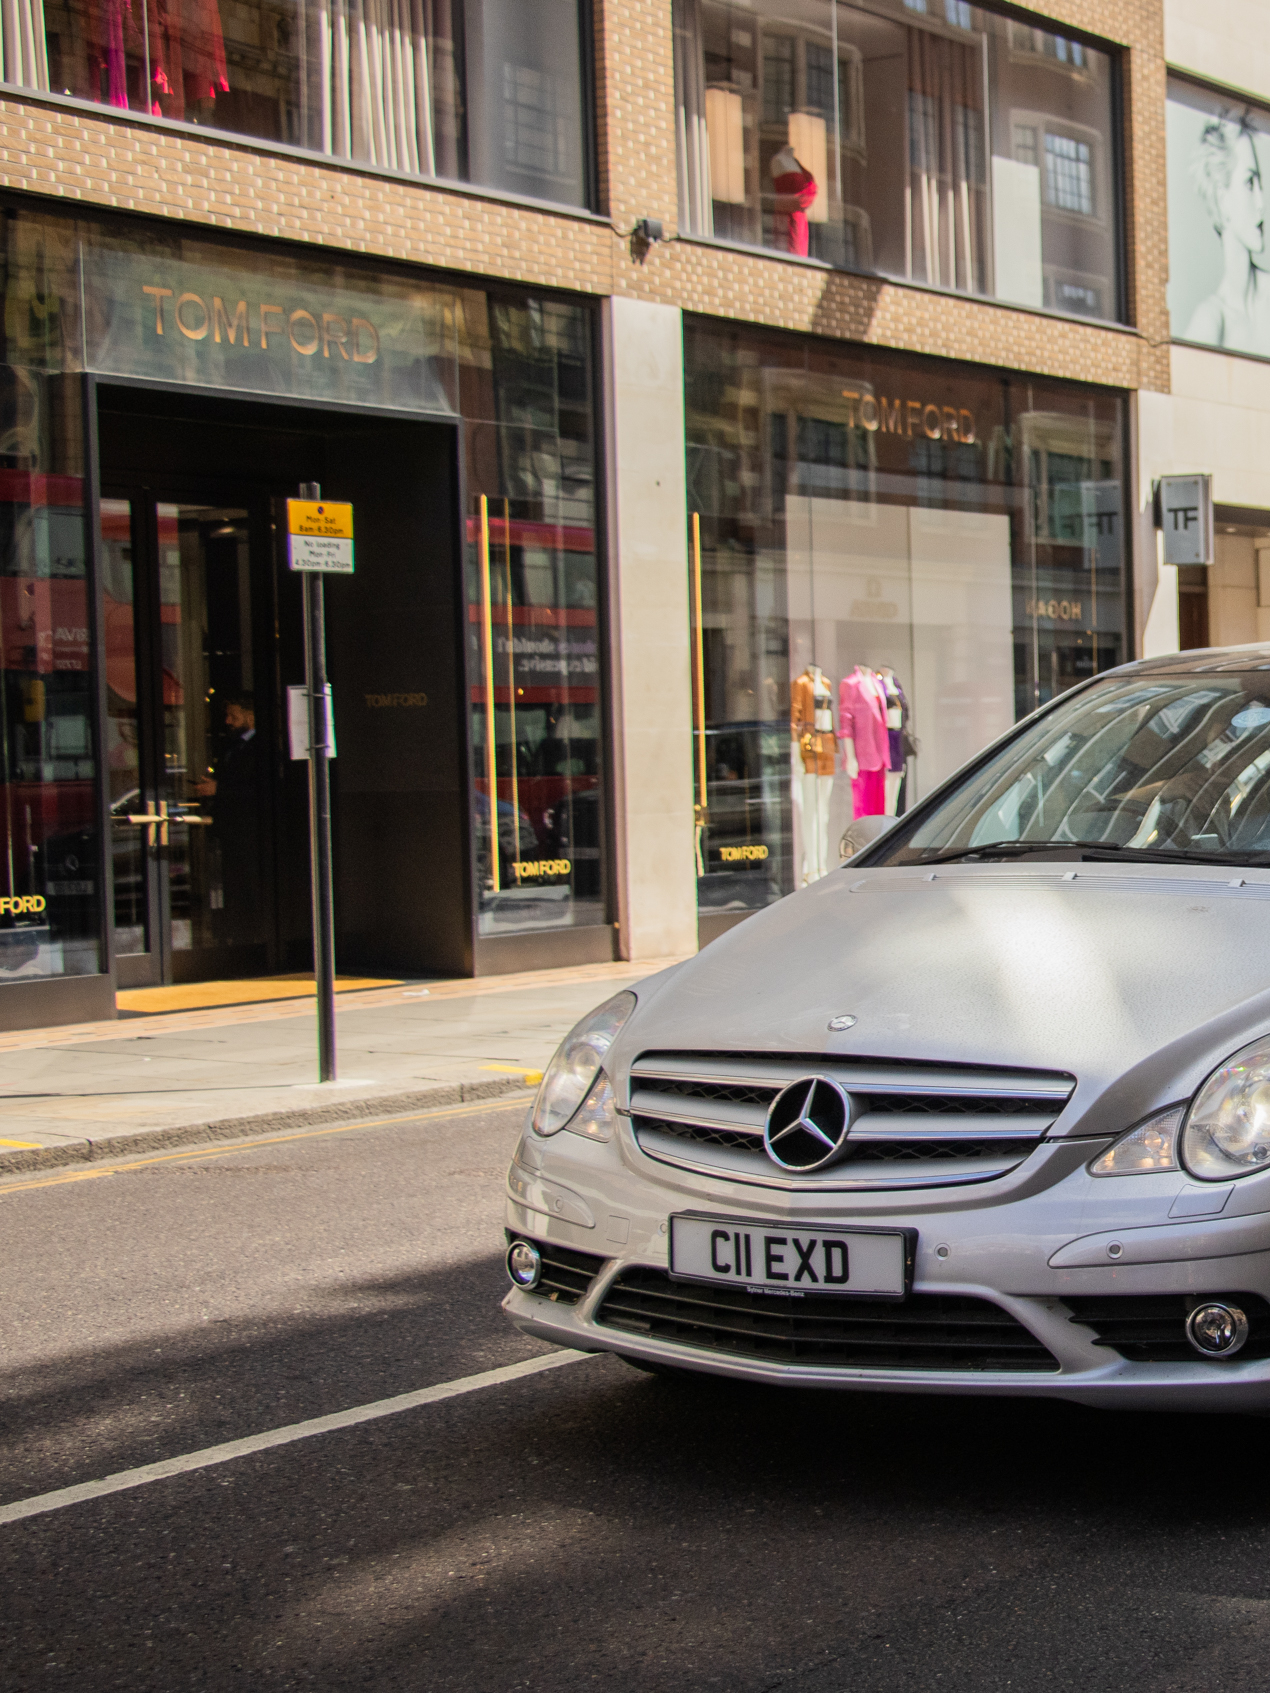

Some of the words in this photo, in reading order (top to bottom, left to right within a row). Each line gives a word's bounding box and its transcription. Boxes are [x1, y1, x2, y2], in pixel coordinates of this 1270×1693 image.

[142, 285, 249, 347] TOM
[260, 303, 380, 364] FORD
[842, 390, 903, 433] TOM
[906, 400, 976, 444] FORD
[1166, 506, 1198, 531] TF
[304, 540, 314, 548] No
[317, 542, 340, 550] loading
[719, 847, 742, 861] TOM
[742, 845, 769, 860] FORD
[512, 861, 539, 878] TOM
[539, 859, 572, 875] FORD
[0, 895, 46, 914] FORD
[710, 1229, 753, 1277] C11
[763, 1235, 850, 1284] EXD
